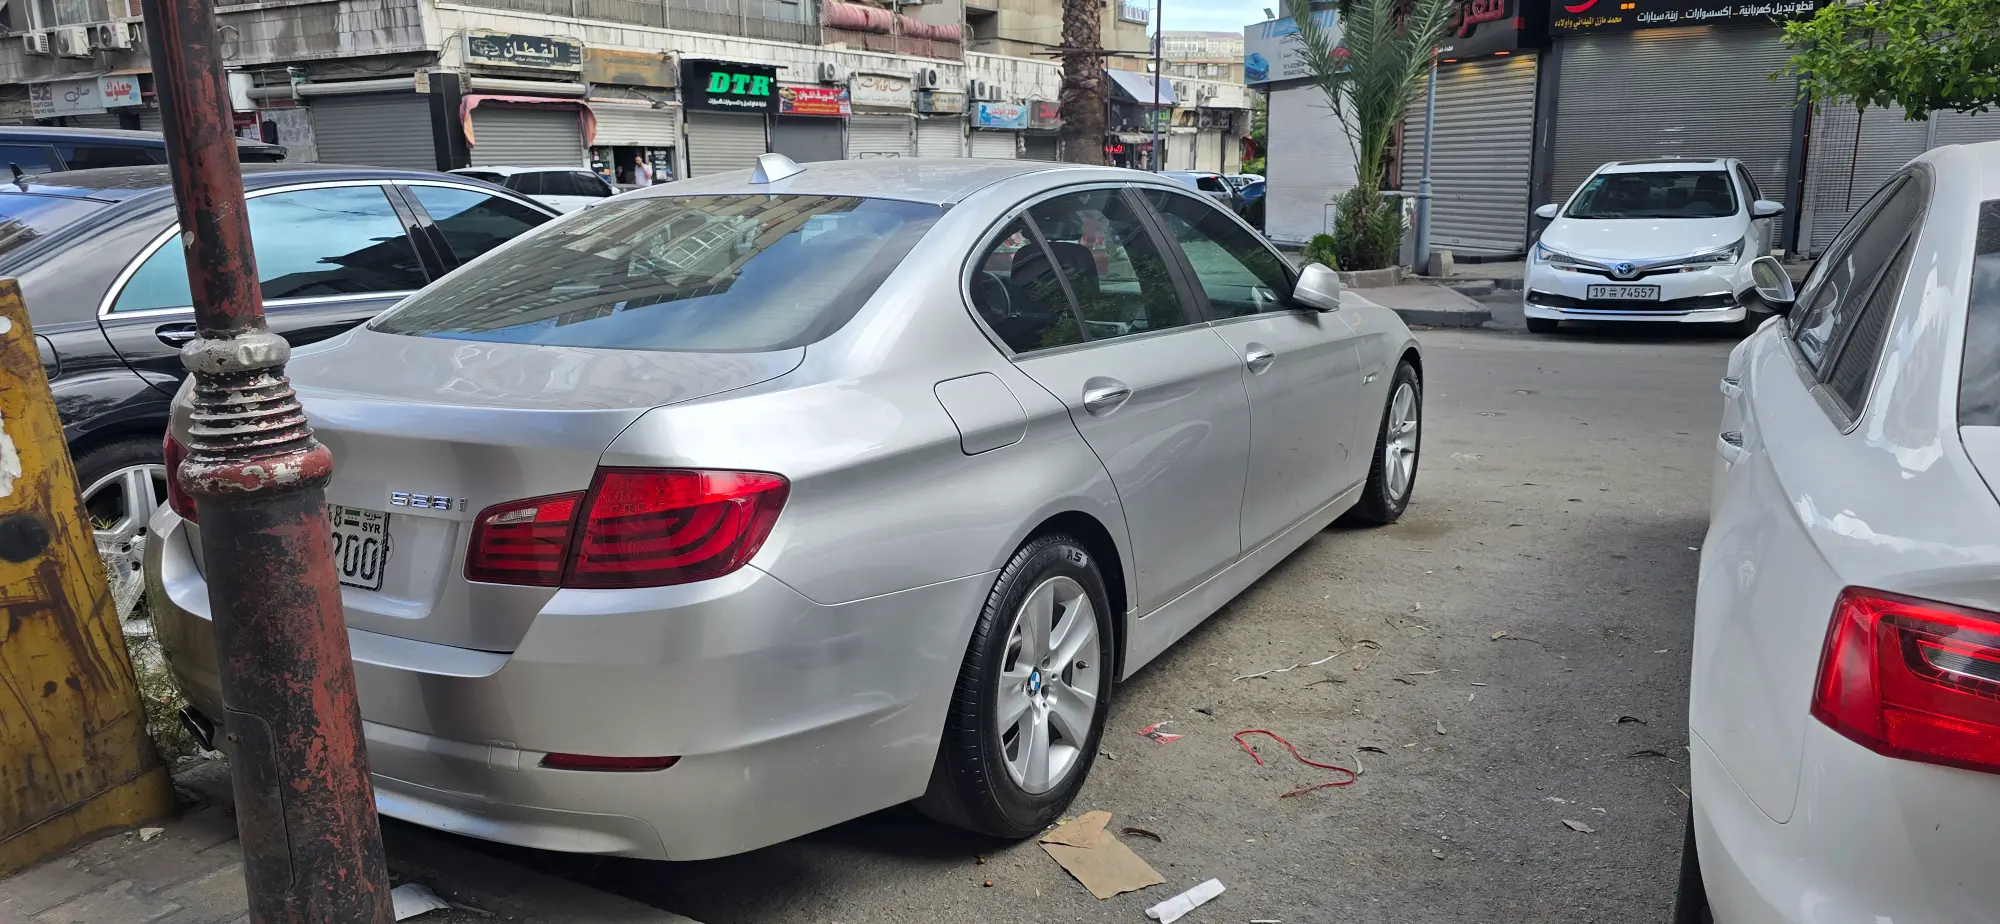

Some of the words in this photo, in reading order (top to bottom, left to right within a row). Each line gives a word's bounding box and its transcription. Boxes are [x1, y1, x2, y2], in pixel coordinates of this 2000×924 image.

[1637, 11, 1664, 23] سيارات
[503, 41, 559, 58] القطان
[706, 72, 770, 96] DTR
[1593, 287, 1606, 298] 19
[1620, 287, 1655, 298] 74557
[363, 510, 383, 521] سورية
[362, 522, 381, 534] SYR
